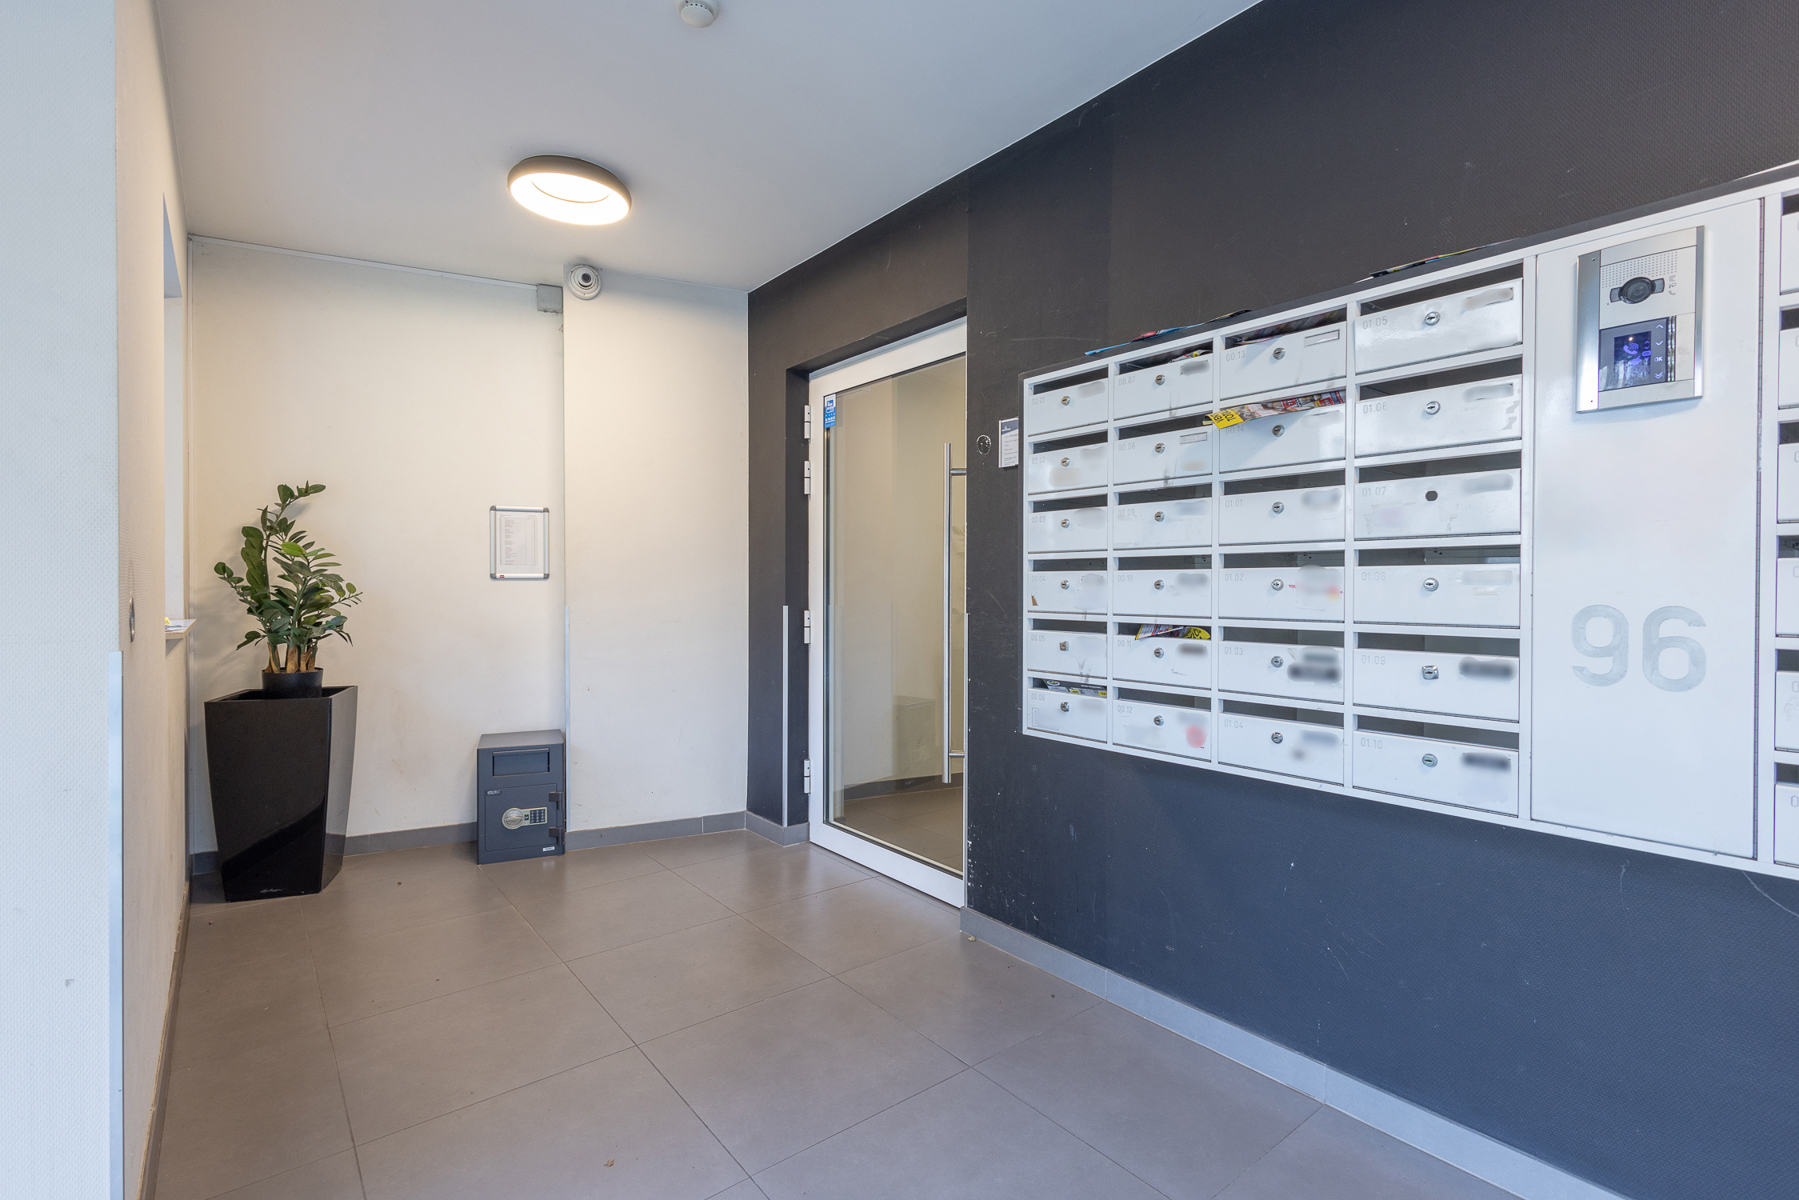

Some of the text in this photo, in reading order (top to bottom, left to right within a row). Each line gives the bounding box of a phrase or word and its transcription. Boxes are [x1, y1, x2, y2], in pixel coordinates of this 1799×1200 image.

[1363, 315, 1388, 330] 01.05
[1226, 350, 1245, 361] 00.13
[1571, 604, 1706, 692] 96
[1361, 737, 1383, 749] 01.10
